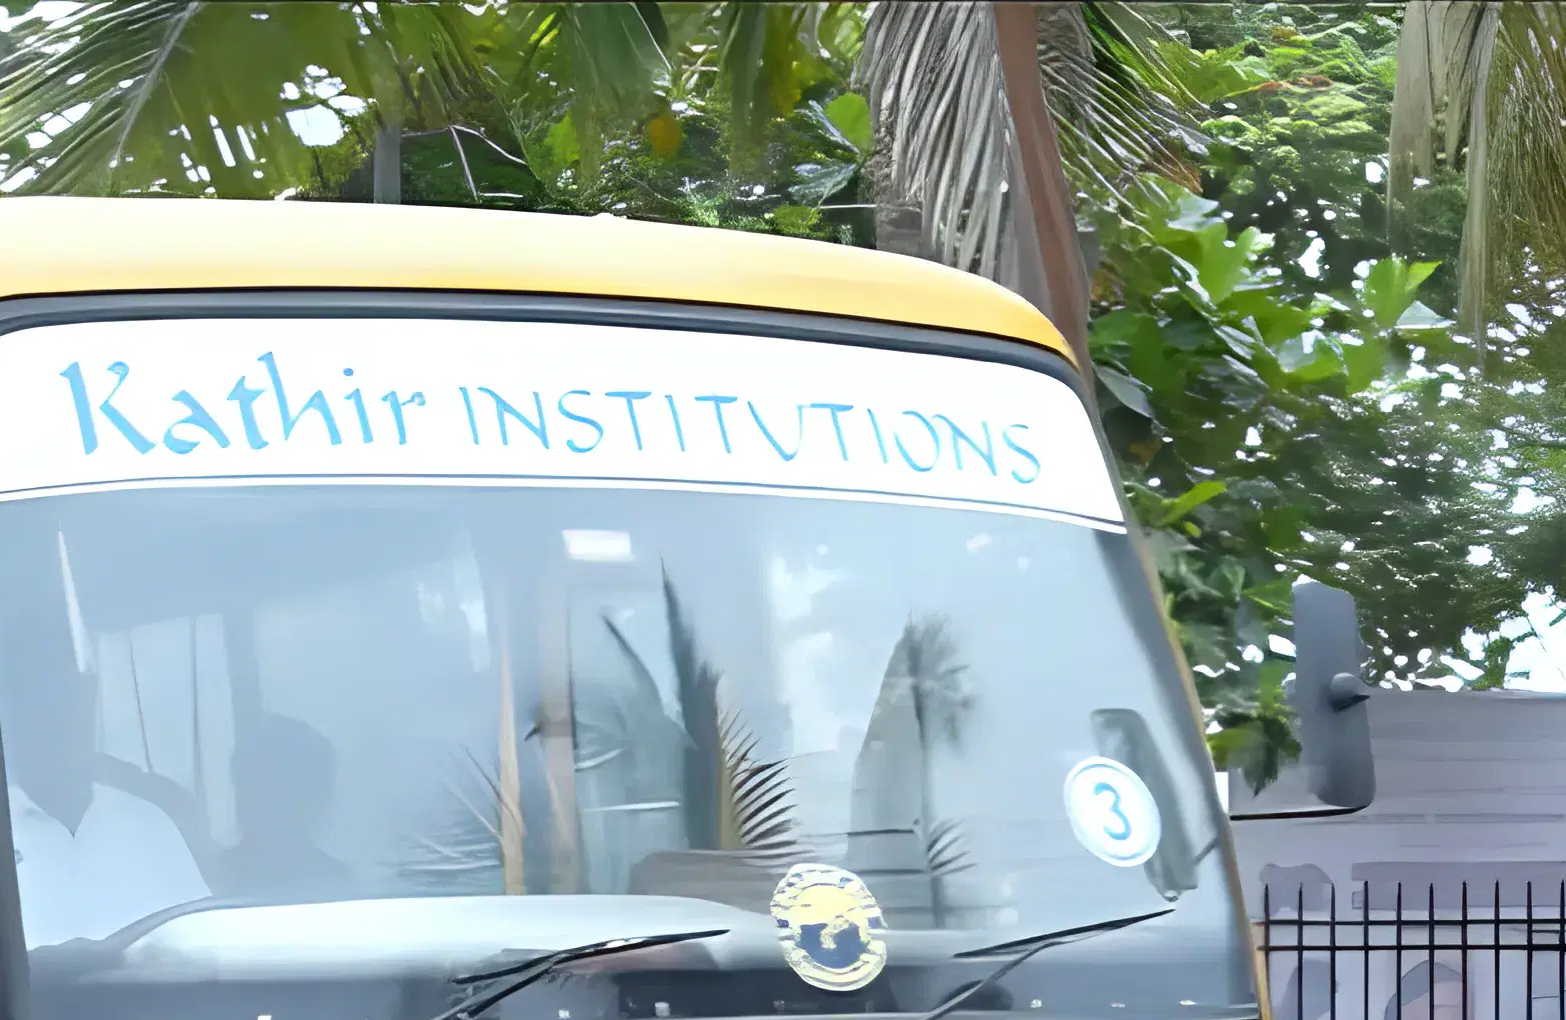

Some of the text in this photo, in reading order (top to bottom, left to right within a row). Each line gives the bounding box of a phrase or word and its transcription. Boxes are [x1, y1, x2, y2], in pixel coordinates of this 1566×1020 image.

[59, 351, 1041, 486] Kathir INSTITUTIONS
[1093, 781, 1132, 841] 3
